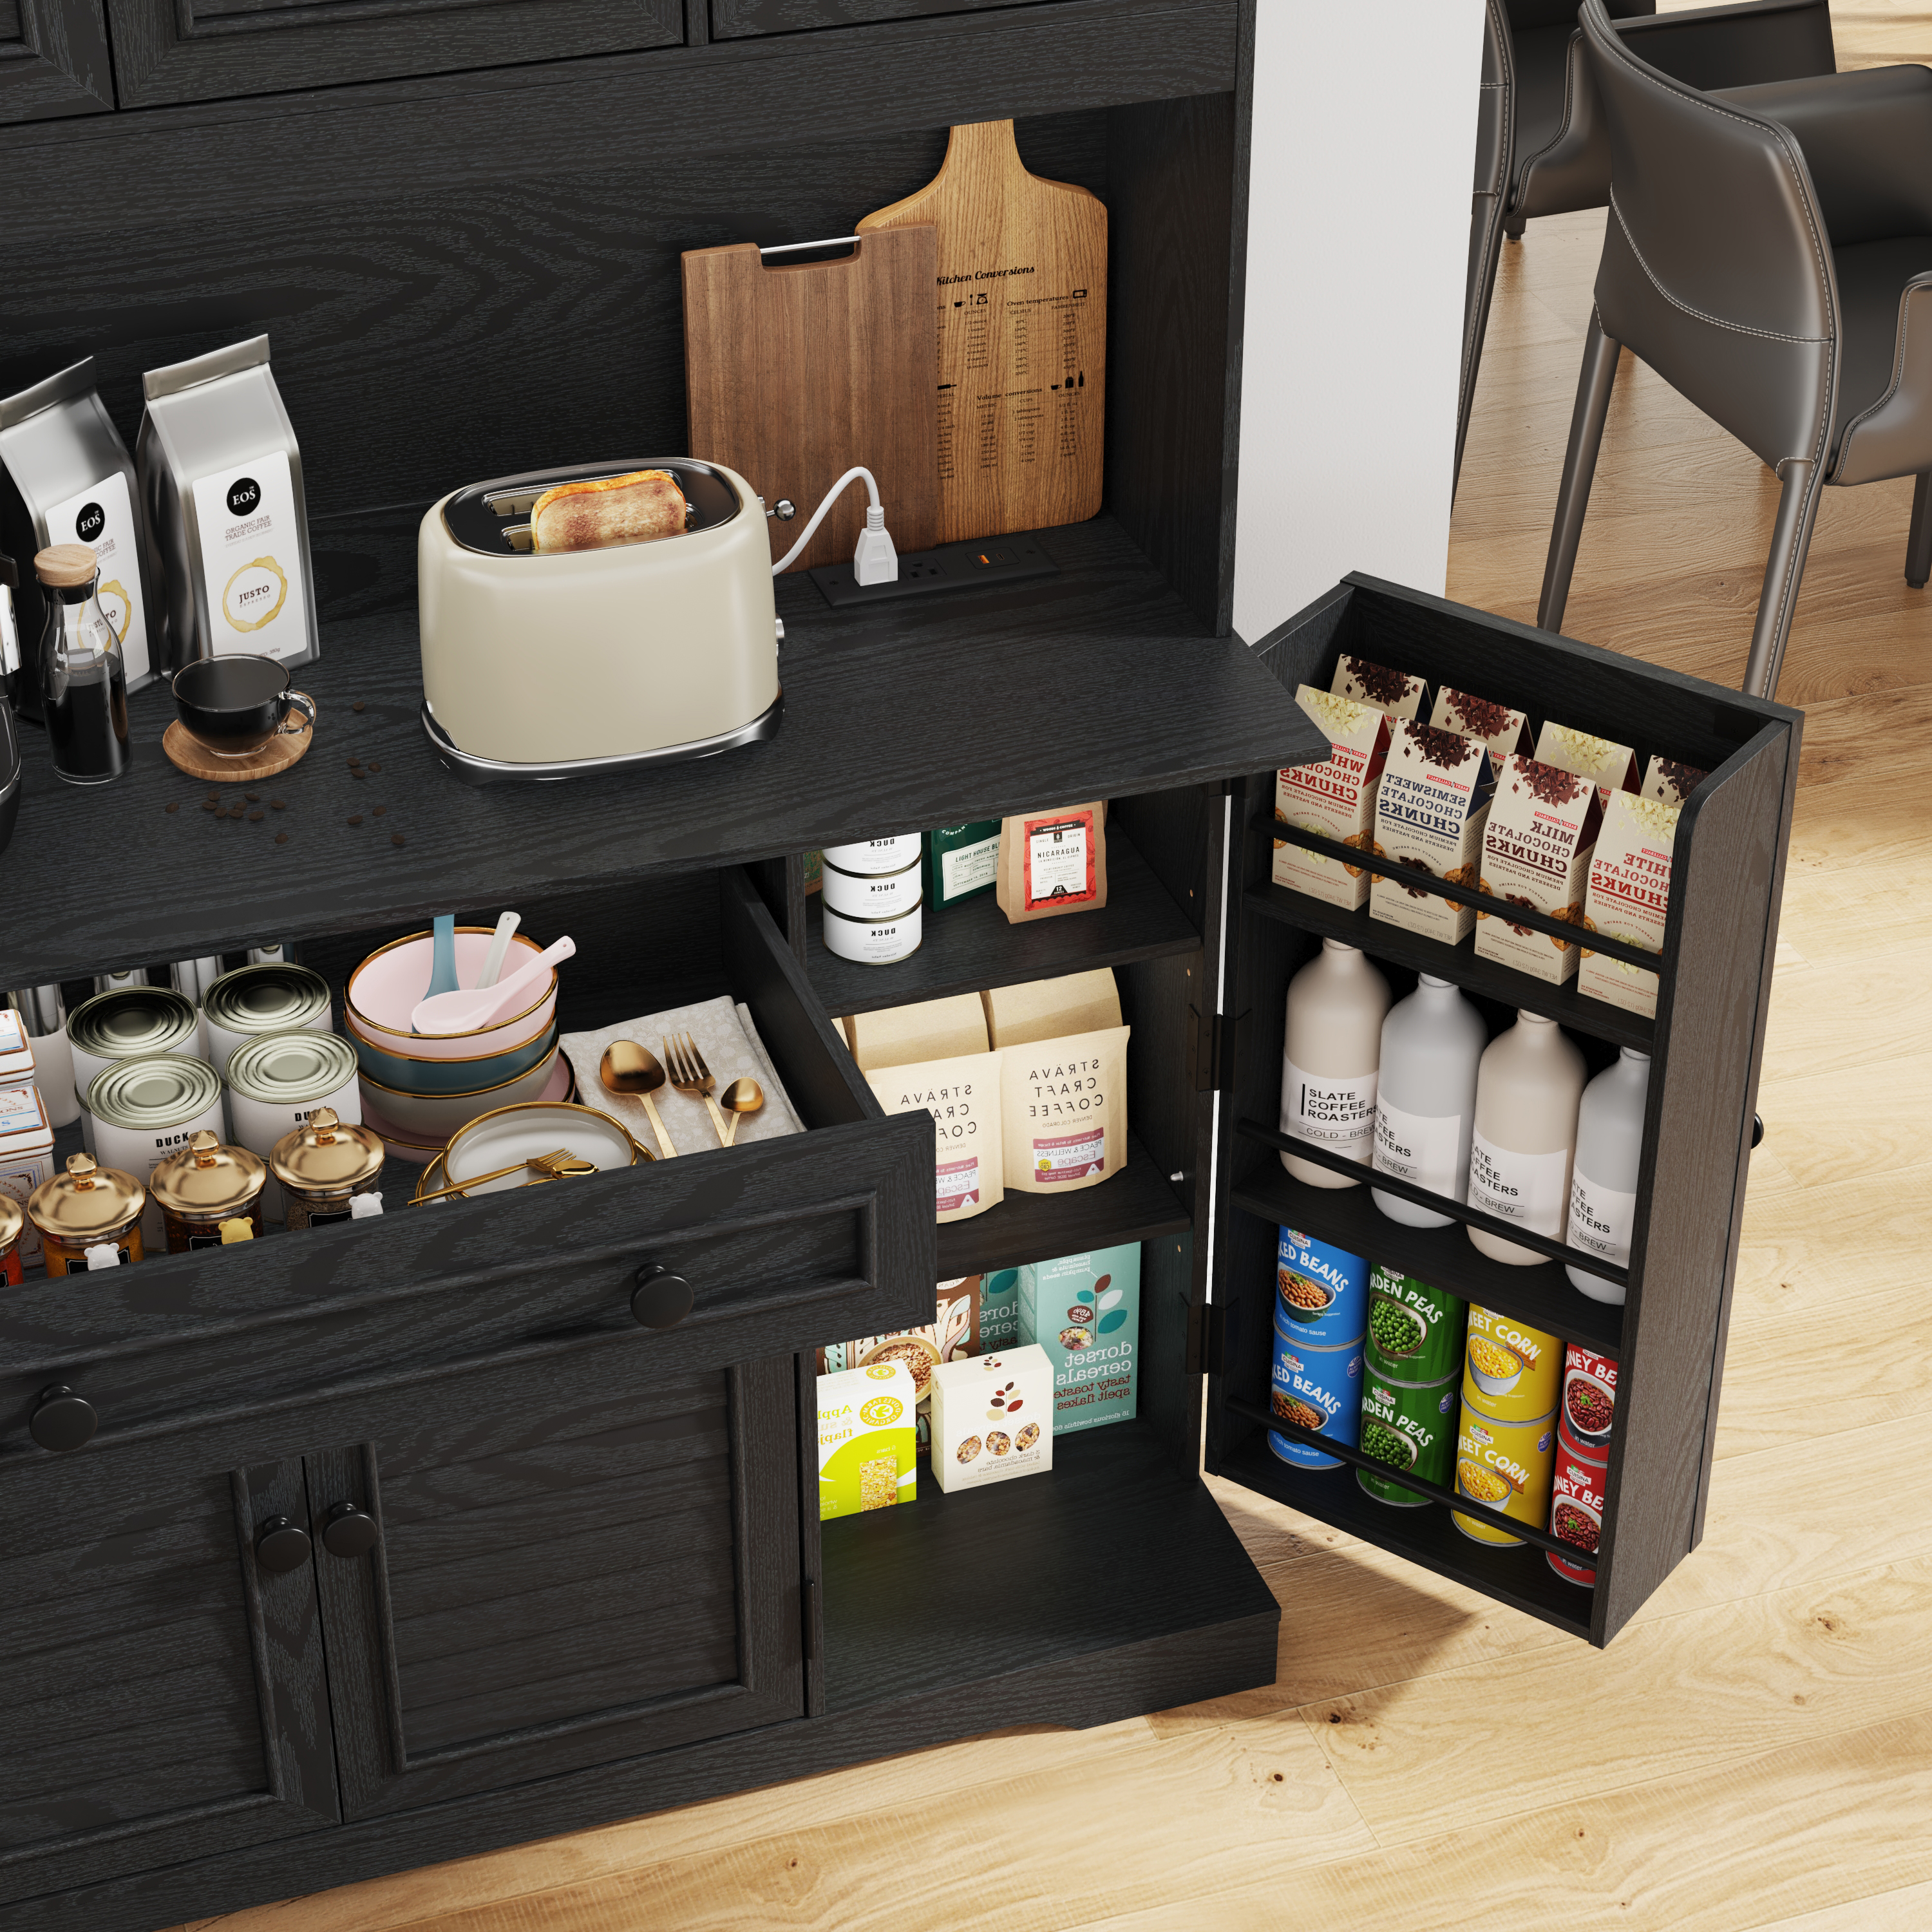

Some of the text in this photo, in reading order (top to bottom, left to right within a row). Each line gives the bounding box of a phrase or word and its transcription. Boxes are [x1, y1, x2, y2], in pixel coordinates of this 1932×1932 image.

[937, 265, 1034, 286] Kitchen Conversions
[1026, 296, 1069, 304] temperatures
[1005, 388, 1042, 397] conversions
[232, 489, 256, 506] EOS
[81, 513, 100, 532] EOS
[225, 515, 270, 535] ORGANIC FAIR
[225, 530, 246, 541] TRADE
[247, 520, 272, 533] COFFEE
[103, 538, 114, 549] FAIR
[239, 585, 269, 603] JUSTO
[955, 845, 990, 862] LIGHT HOUSE
[1037, 847, 1080, 858] NICARAGUA
[1309, 1088, 1356, 1101] SLATE
[1307, 1104, 1377, 1121] ROASTERS
[1309, 1100, 1365, 1111] COFFEE
[156, 1132, 189, 1148] DUCK
[1306, 1128, 1338, 1139] COLD
[1383, 1156, 1408, 1174] BREW
[1485, 1197, 1515, 1213] BREW
[1571, 1202, 1610, 1233] ASTERS
[1289, 1232, 1309, 1245] CUISINA
[1579, 1231, 1607, 1251] BREW
[1300, 1251, 1349, 1292] BEANS
[1405, 1290, 1443, 1324] PEAS
[1291, 1322, 1308, 1333] tomato
[1495, 1325, 1542, 1361] CORN
[1282, 1356, 1302, 1370] CUISINA
[1383, 1359, 1398, 1368] water
[1293, 1374, 1341, 1414] BEANS
[1374, 1389, 1394, 1403] CUISINA
[1482, 1398, 1497, 1407] water
[1396, 1415, 1434, 1447] PEAS
[1471, 1428, 1492, 1443] CUISINA
[1283, 1443, 1302, 1454] tomato
[1580, 1439, 1595, 1448] water
[1484, 1450, 1530, 1485] CORN
[1568, 1468, 1589, 1483] CUISINA
[1375, 1480, 1390, 1490] water
[1567, 1561, 1582, 1571] water
